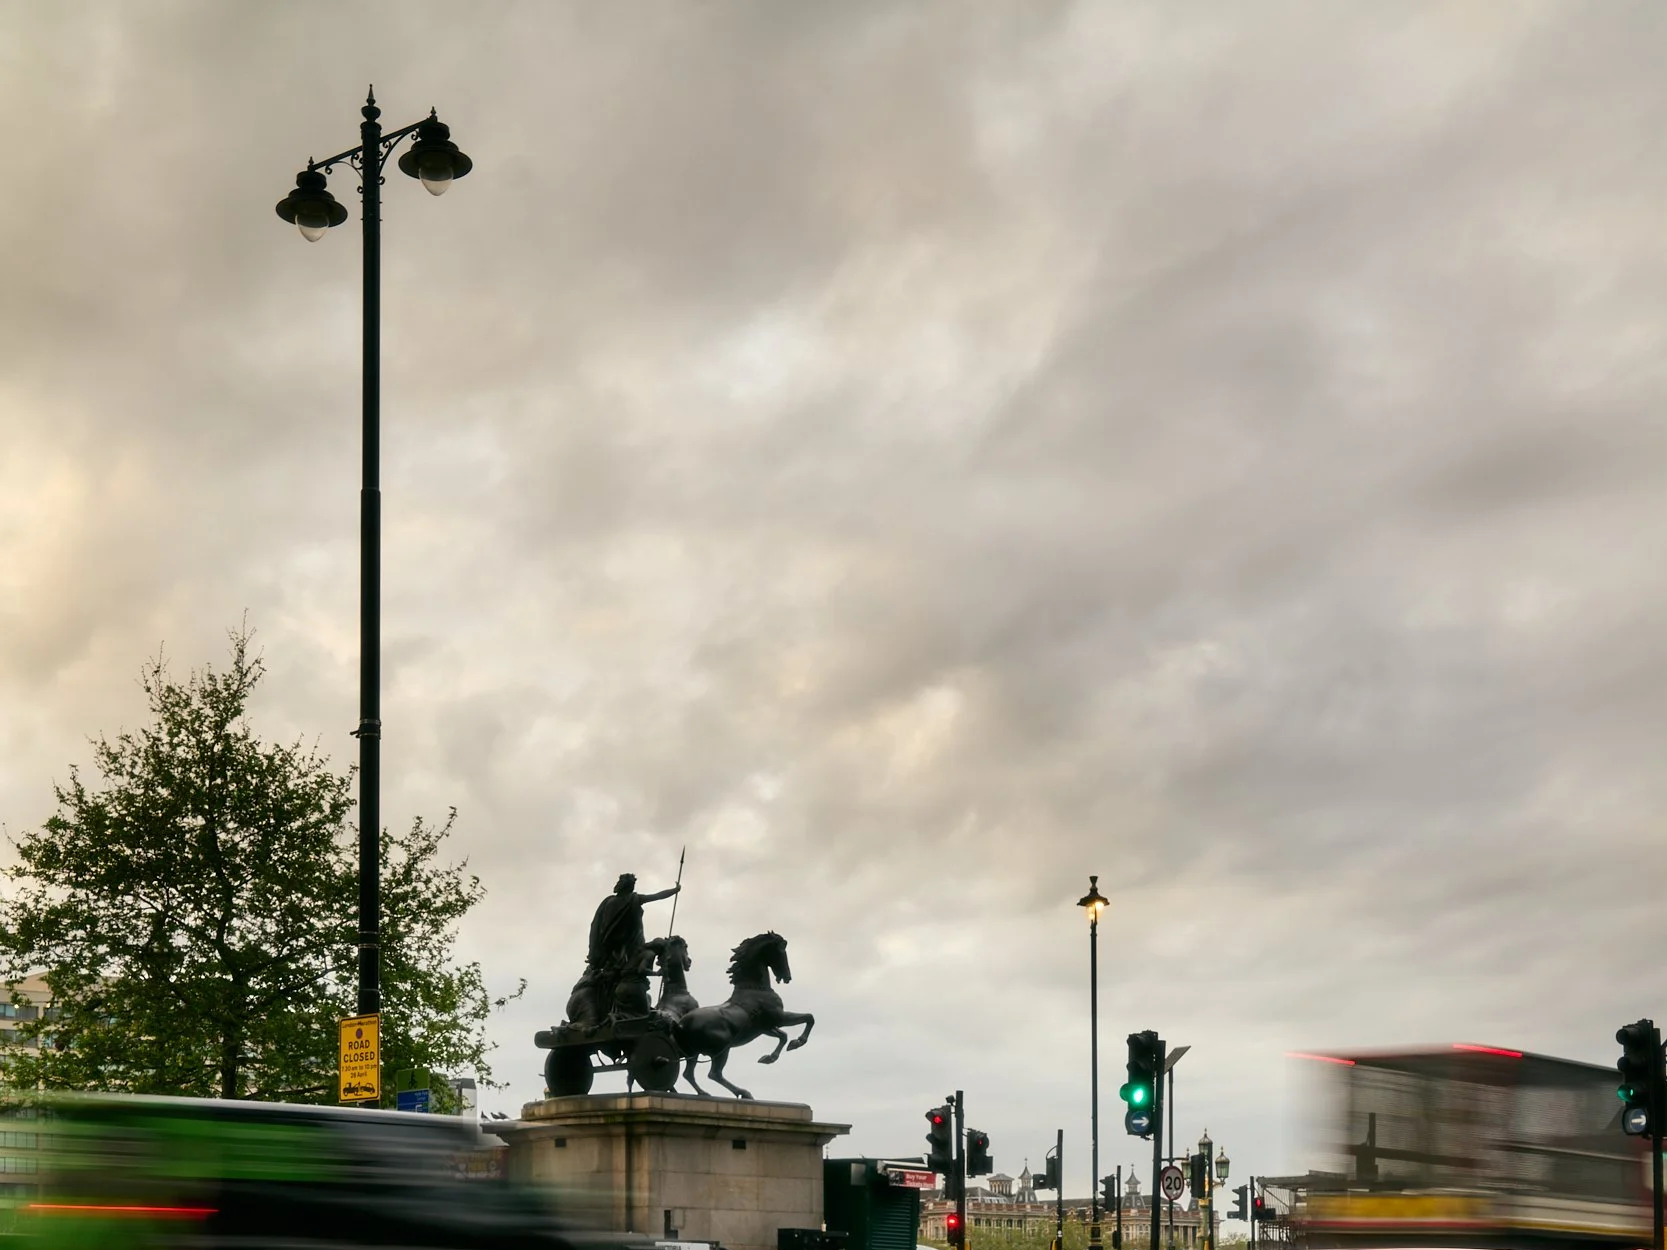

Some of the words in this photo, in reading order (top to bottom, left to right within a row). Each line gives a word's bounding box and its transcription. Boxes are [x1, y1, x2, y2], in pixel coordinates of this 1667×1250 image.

[348, 1039, 370, 1050] ROAD
[343, 1051, 375, 1063] CLOSED
[1165, 1176, 1181, 1190] 20
